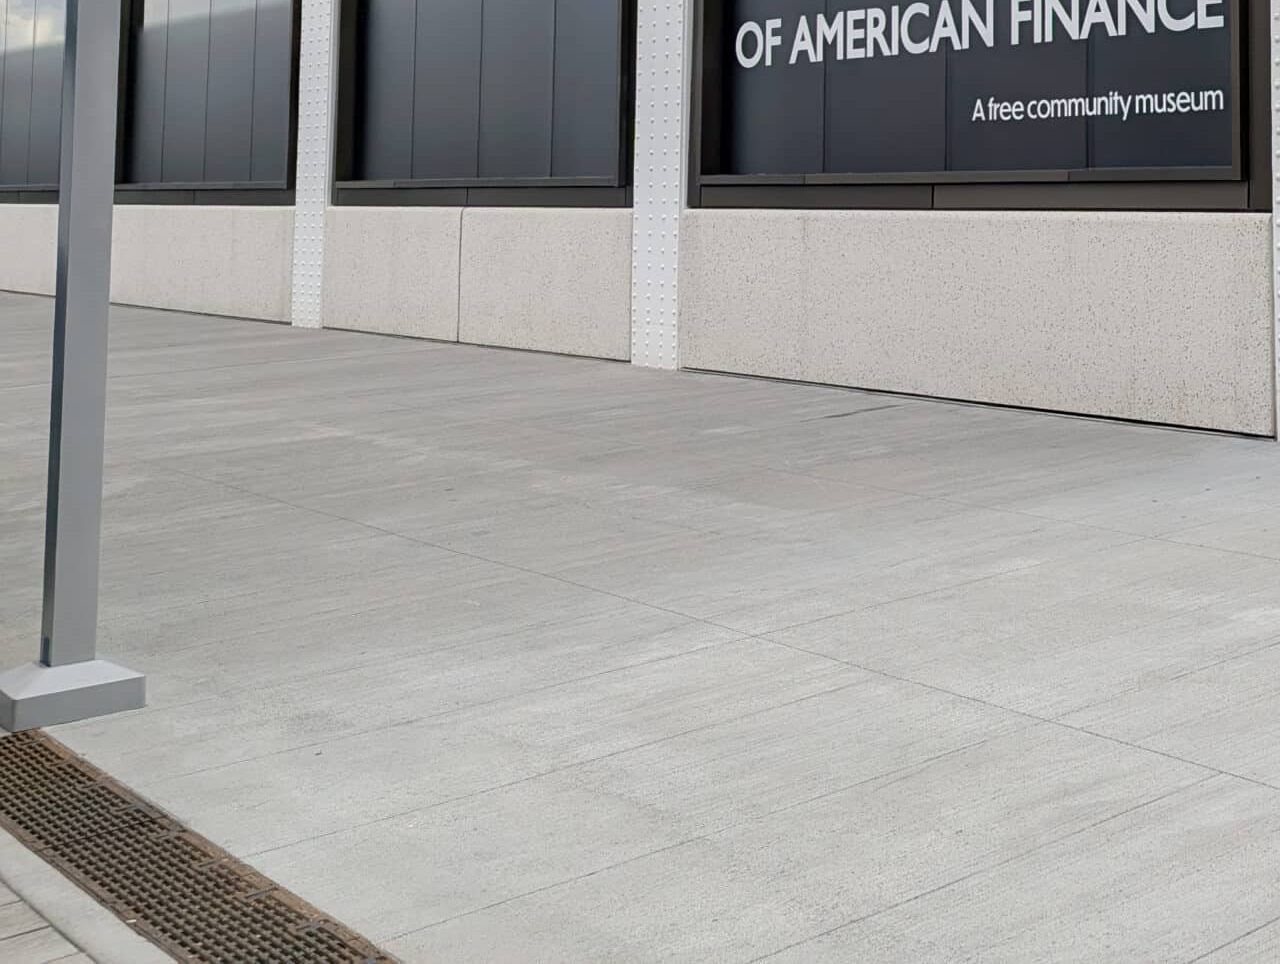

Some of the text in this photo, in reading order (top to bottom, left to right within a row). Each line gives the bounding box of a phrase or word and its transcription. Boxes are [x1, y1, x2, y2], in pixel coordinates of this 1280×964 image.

[735, 18, 782, 68] OF
[972, 89, 1224, 121] A free community museum
